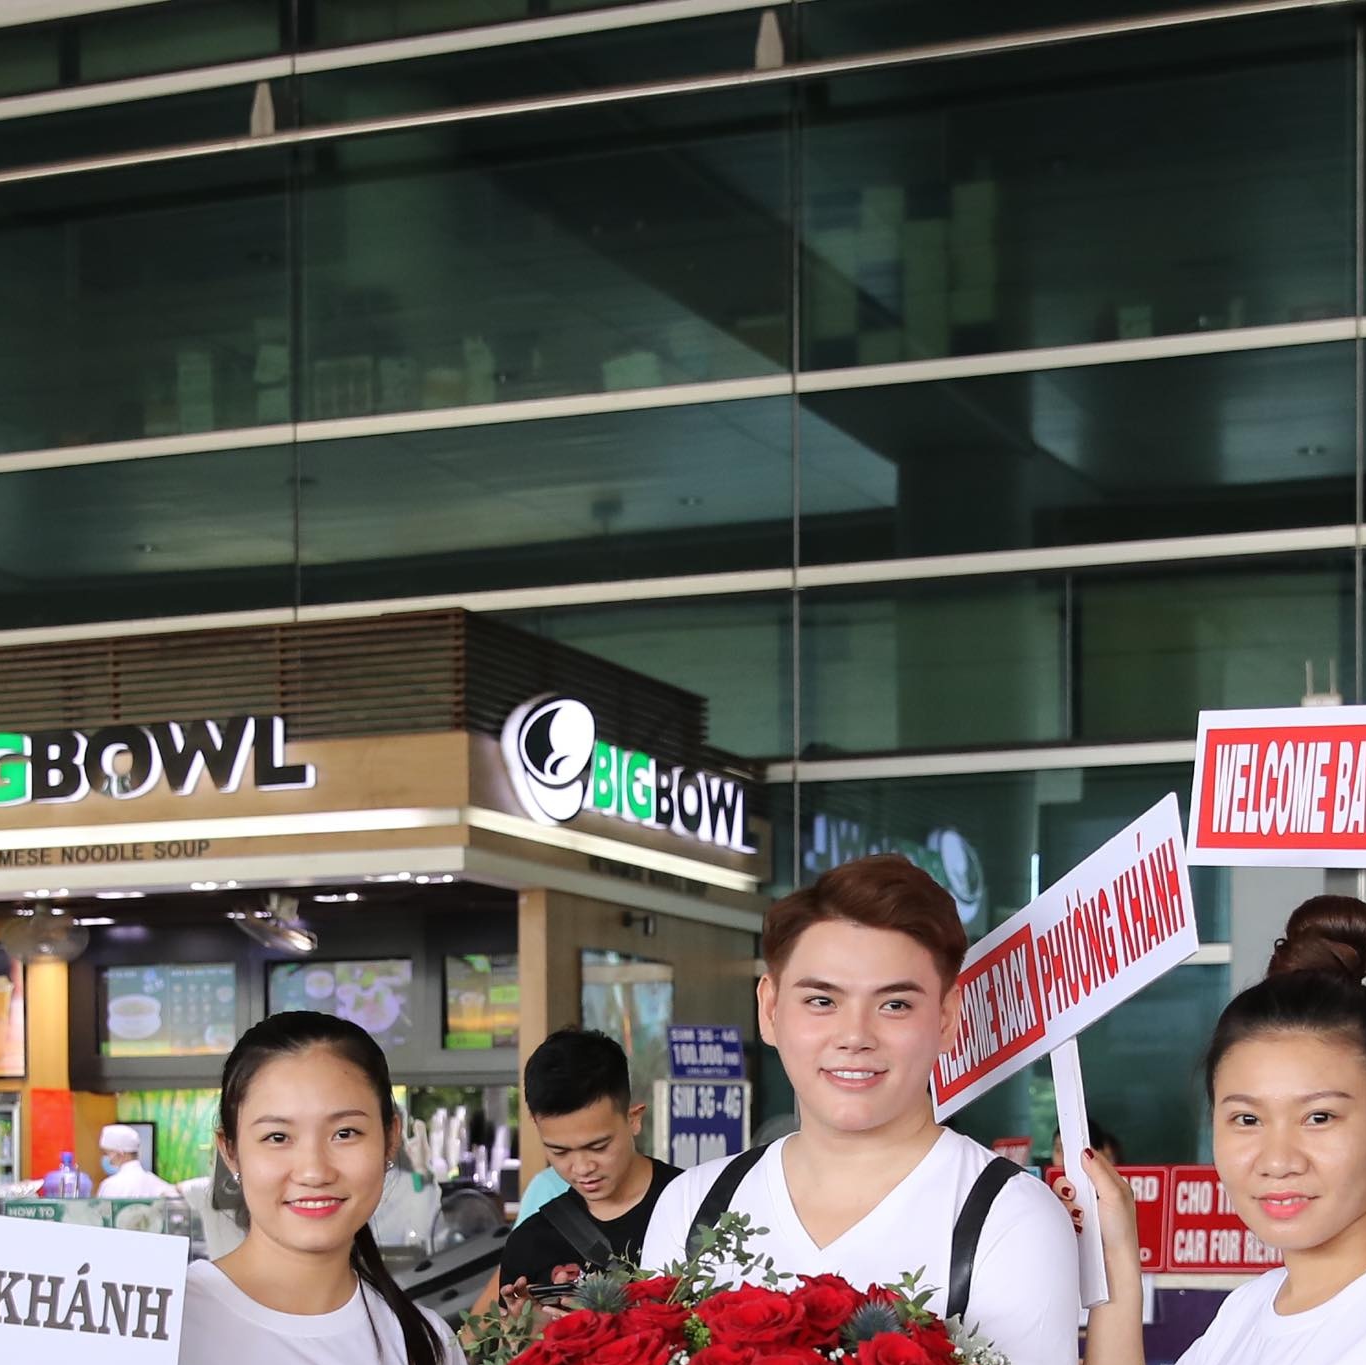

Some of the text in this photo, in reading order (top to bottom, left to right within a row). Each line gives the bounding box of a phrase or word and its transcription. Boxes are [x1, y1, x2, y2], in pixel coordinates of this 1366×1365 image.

[1211, 741, 1333, 836] WELCOME
[61, 842, 145, 865] NOODLE
[154, 838, 211, 861] SOUP
[994, 943, 1037, 1046] BACK
[1036, 887, 1119, 1022] PHƯƠNG
[1113, 832, 1186, 967] KHÁNH
[672, 1085, 741, 1119] SIM 3G 4G
[8, 1206, 55, 1218] HOW TO
[1176, 1180, 1213, 1215] CHO
[1174, 1229, 1207, 1264] CAR
[1209, 1229, 1241, 1264] FOR
